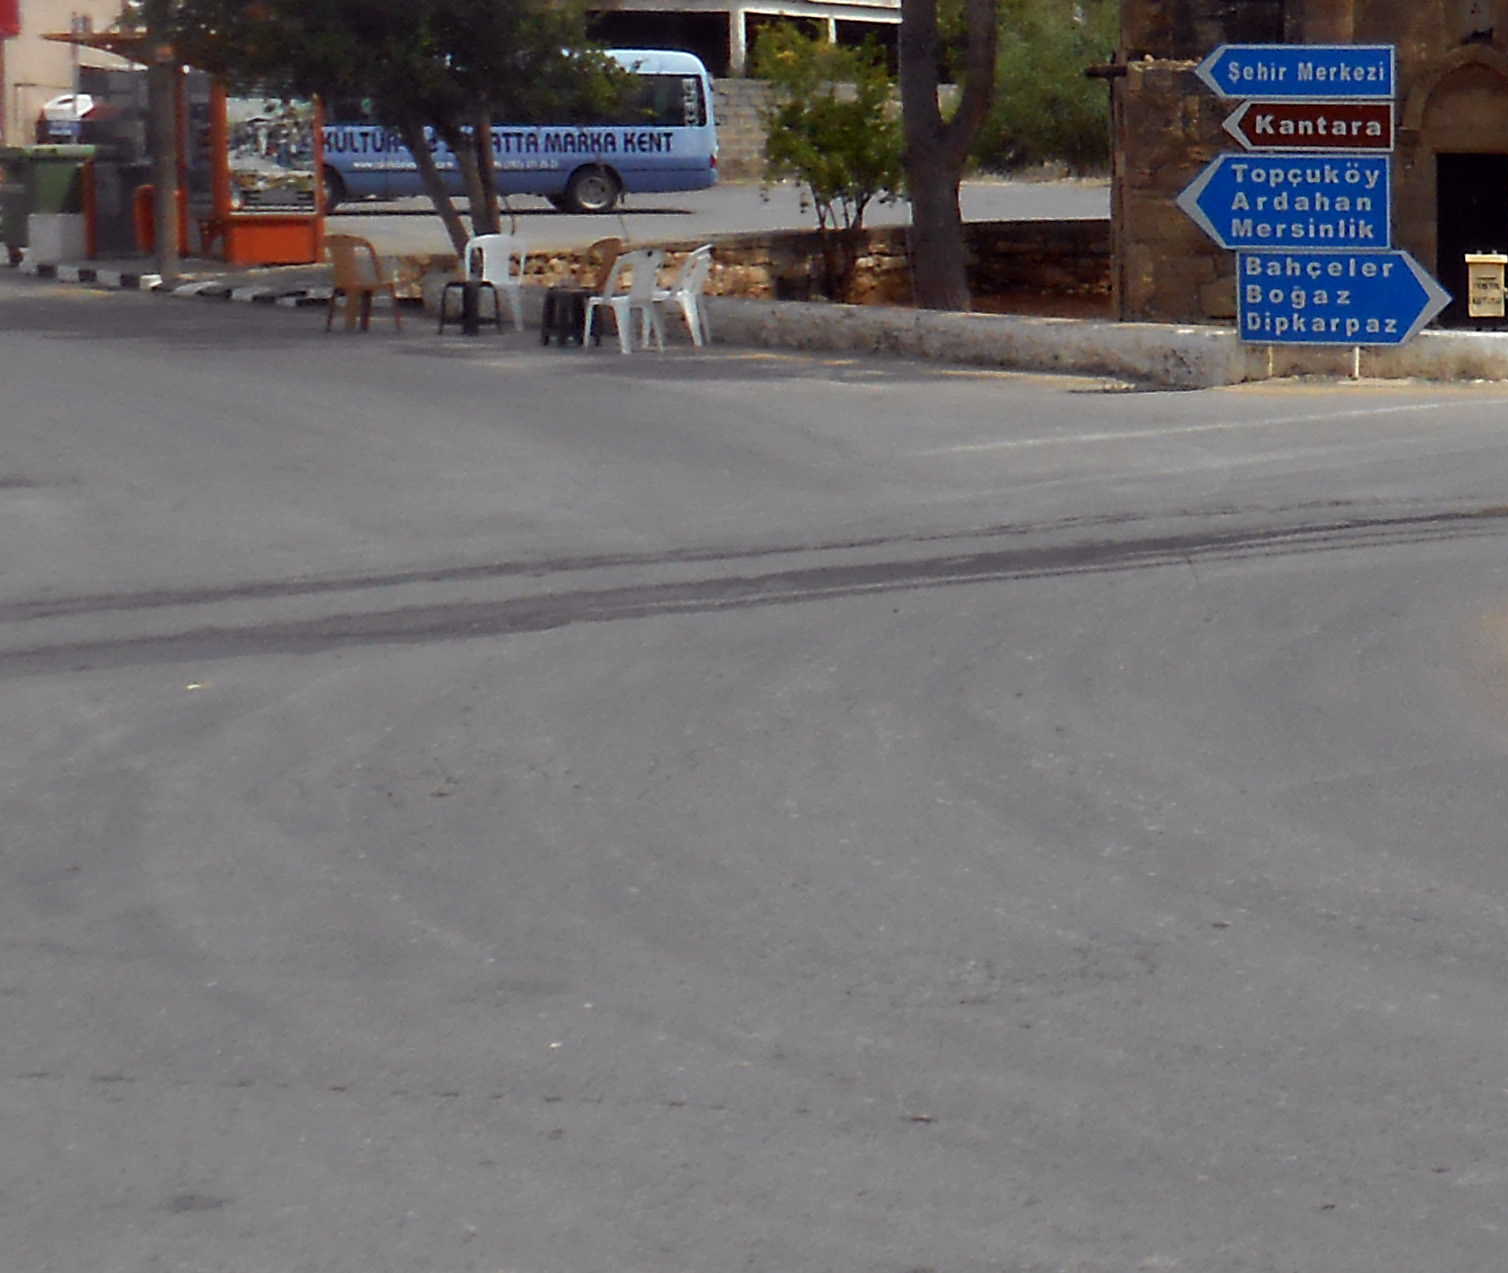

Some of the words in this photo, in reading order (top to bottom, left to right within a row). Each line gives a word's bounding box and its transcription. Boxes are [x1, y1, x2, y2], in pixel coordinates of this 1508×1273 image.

[1228, 61, 1287, 84] Şehir
[1297, 61, 1384, 81] Merkezi
[1255, 114, 1382, 136] Kantara
[544, 132, 617, 153] MARKA
[623, 132, 674, 153] KENT
[1231, 162, 1380, 189] Topçuköy
[1231, 191, 1372, 212] Ardahan
[1231, 217, 1374, 239] Mersinlik
[1245, 256, 1394, 279] Bahçeler
[1246, 285, 1351, 308] Boğaz
[1246, 312, 1397, 336] Dipkarpaz
